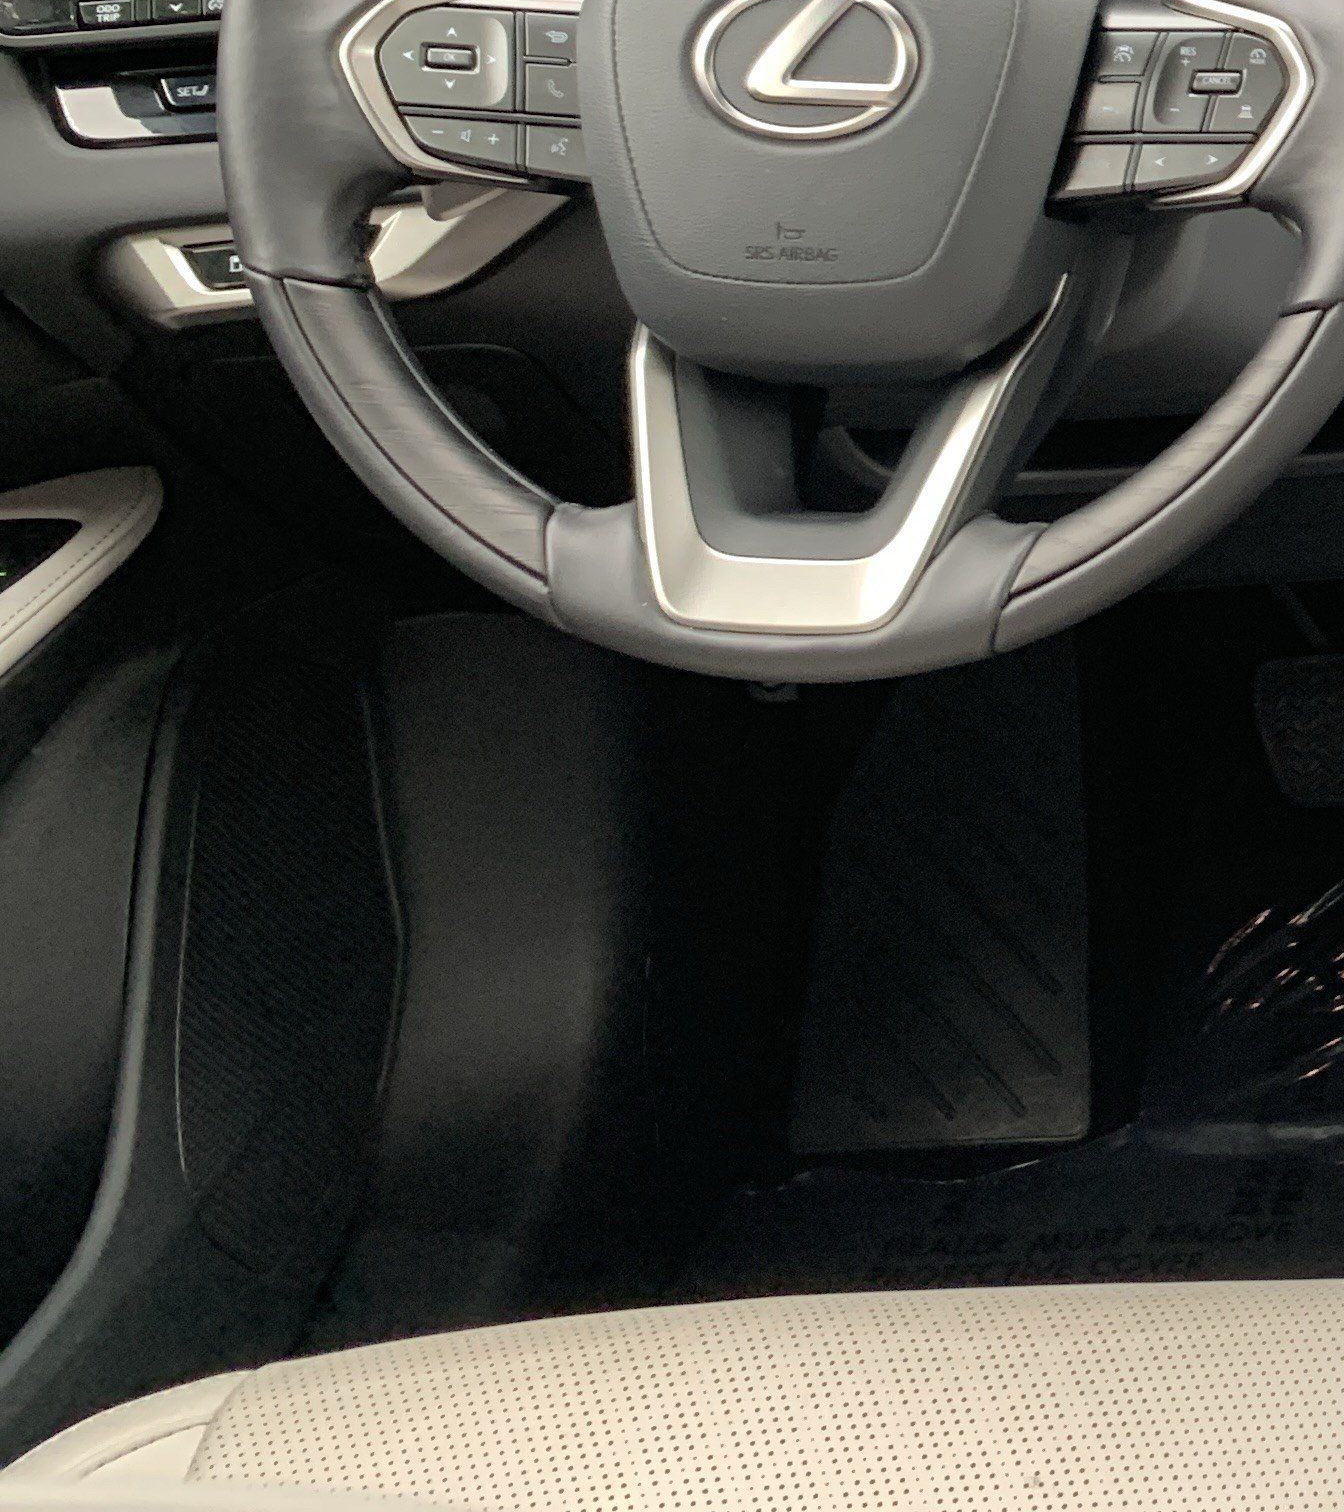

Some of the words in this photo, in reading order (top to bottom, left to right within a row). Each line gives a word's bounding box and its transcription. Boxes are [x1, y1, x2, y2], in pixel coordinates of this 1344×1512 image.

[95, 3, 121, 14] ODO
[96, 13, 121, 23] TRIP
[176, 87, 197, 98] SET
[744, 245, 774, 260] SRS
[779, 246, 839, 262] AIRBAG
